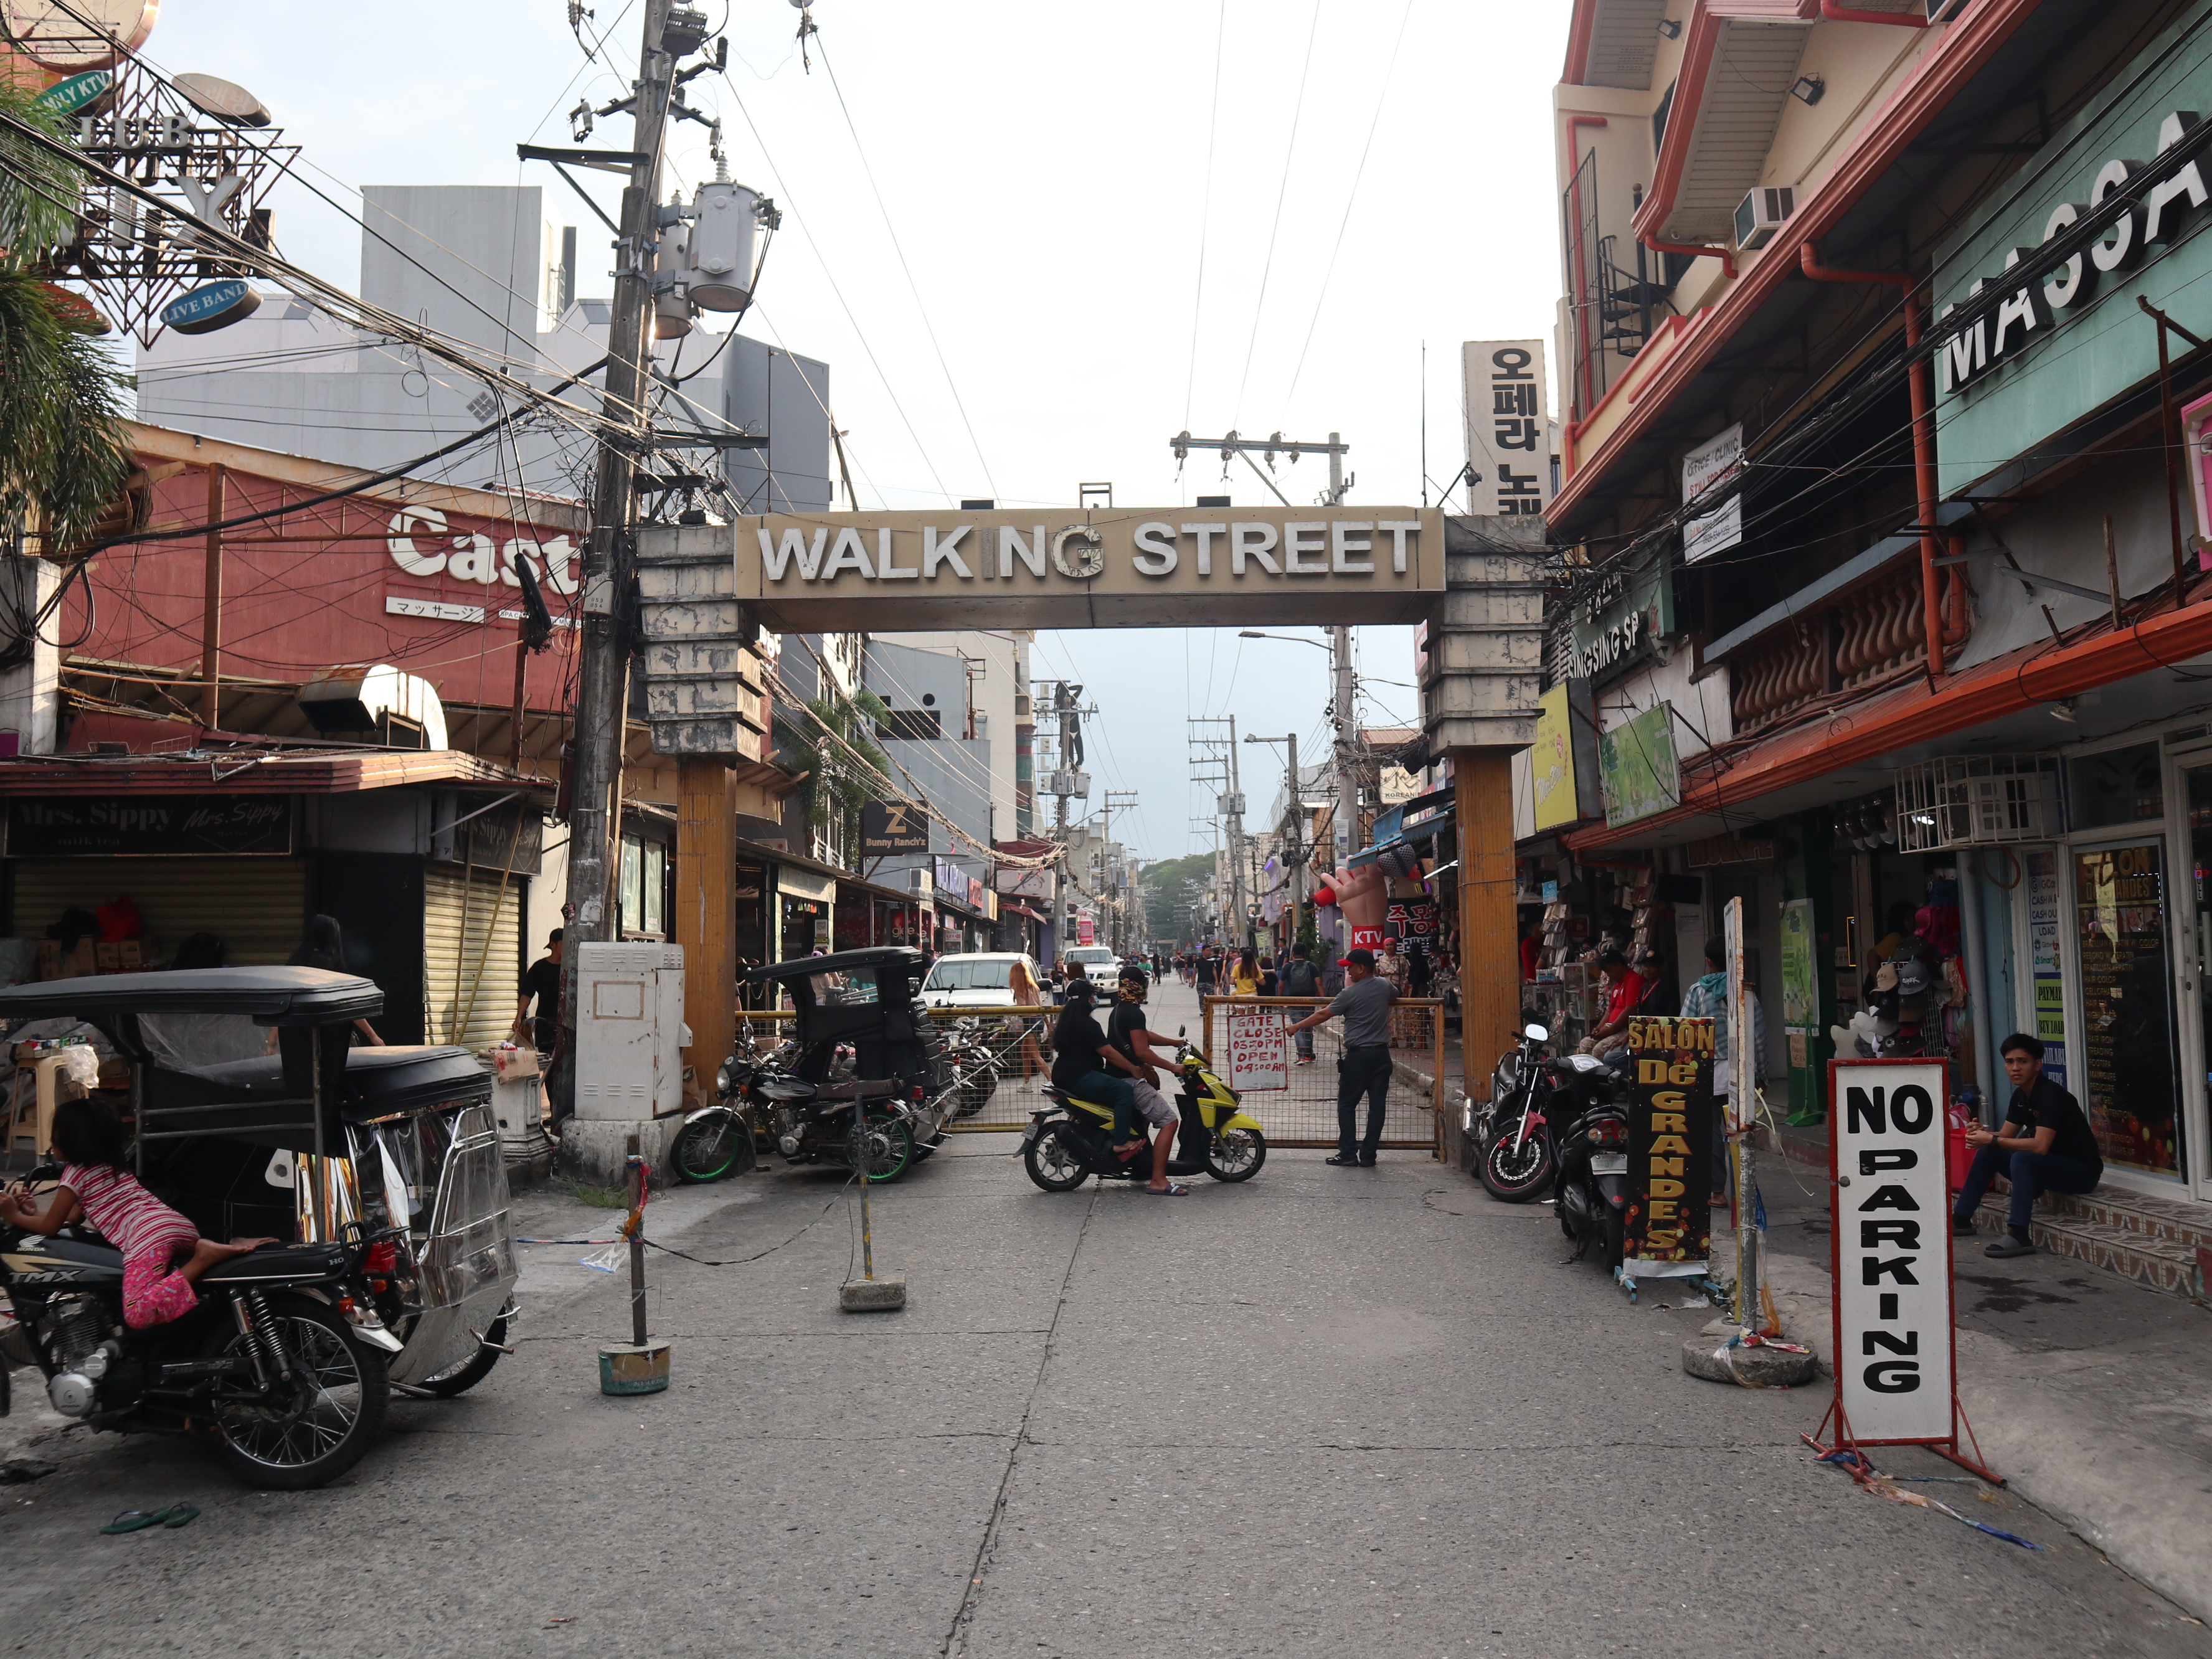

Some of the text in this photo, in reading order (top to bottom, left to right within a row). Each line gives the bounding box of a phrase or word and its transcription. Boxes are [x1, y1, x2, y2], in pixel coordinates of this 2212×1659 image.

[78, 72, 106, 97] KTV
[162, 281, 248, 323] LIVE BAND
[1492, 348, 1540, 451] 오페라
[1687, 453, 1710, 477] OFFICE
[1714, 437, 1739, 462] CLINIC
[387, 505, 584, 595] Cast
[756, 520, 1422, 580] WALKING STREET
[397, 602, 474, 618] マッサージ
[19, 801, 175, 831] Mrs. Sippy
[182, 801, 284, 832] Mrs. Sippy
[884, 806, 908, 833] Z
[59, 836, 120, 846] milk tea
[866, 836, 926, 849] Bunny Ranch'z
[1386, 904, 1431, 938] 주몽
[2032, 910, 2047, 920] CASH
[2038, 925, 2056, 936] LOAD
[1354, 930, 1382, 945] KTV
[2139, 938, 2159, 947] COLOR
[2082, 951, 2104, 960] REBOND
[2097, 975, 2116, 983] COLOR
[2084, 987, 2110, 995] CELLOPHA
[2085, 999, 2097, 1007] HAIR
[1237, 1016, 1274, 1027] GATE
[2039, 1019, 2064, 1034] BUY LOAD
[1233, 1027, 1281, 1038] CLOSE
[1628, 1022, 1714, 1051] SALON
[2087, 1034, 2114, 1044] HAIR IRON
[1237, 1051, 1278, 1062] OPEN
[2087, 1046, 2114, 1056] TREADING
[2089, 1059, 2111, 1067] FOOTSPA
[1638, 1059, 1697, 1085] De
[2089, 1071, 2116, 1081] MANICURE
[2090, 1082, 2114, 1093] PEDICURE
[2103, 1095, 2114, 1105] GEL
[1846, 1084, 1934, 1135] NO
[1647, 1091, 1693, 1249] GRANDES
[9, 1270, 82, 1283] TMX
[1858, 1149, 1921, 1394] PARKING
